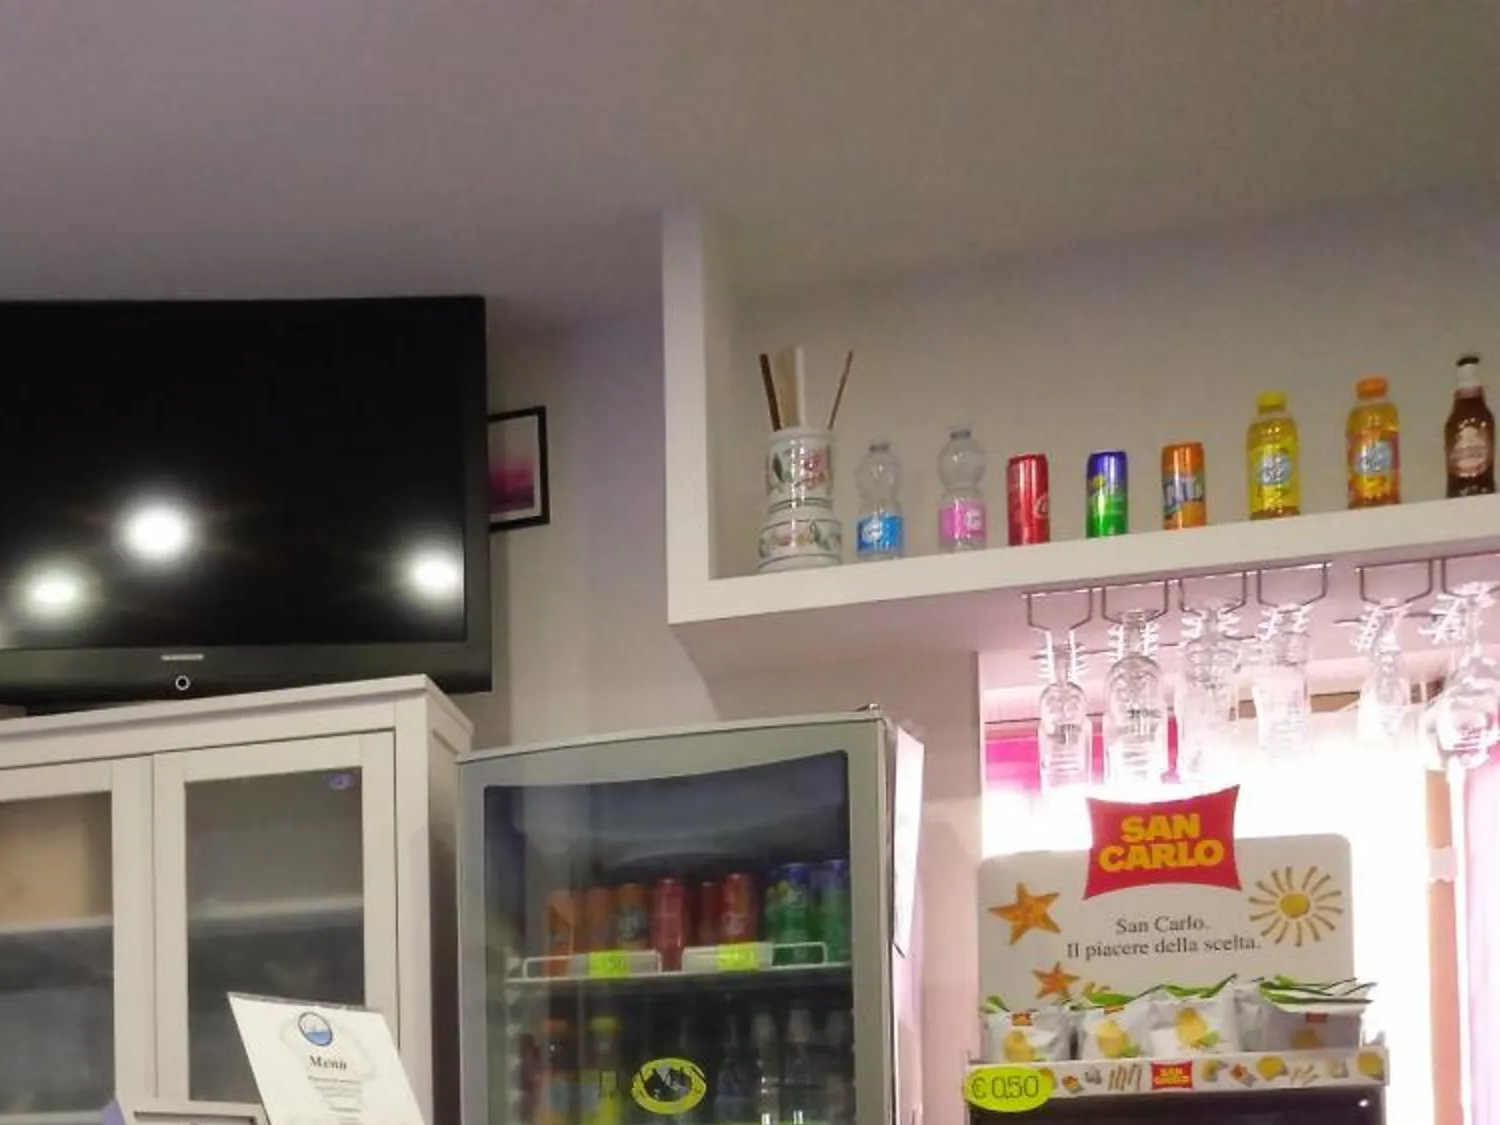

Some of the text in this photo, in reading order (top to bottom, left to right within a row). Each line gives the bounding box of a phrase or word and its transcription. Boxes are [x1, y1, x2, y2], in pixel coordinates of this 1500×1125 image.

[1120, 812, 1200, 843] SAN
[1098, 838, 1225, 874] CARLO
[1115, 914, 1211, 935] San Carlo.
[1067, 934, 1261, 961] Il piacere della scelta.
